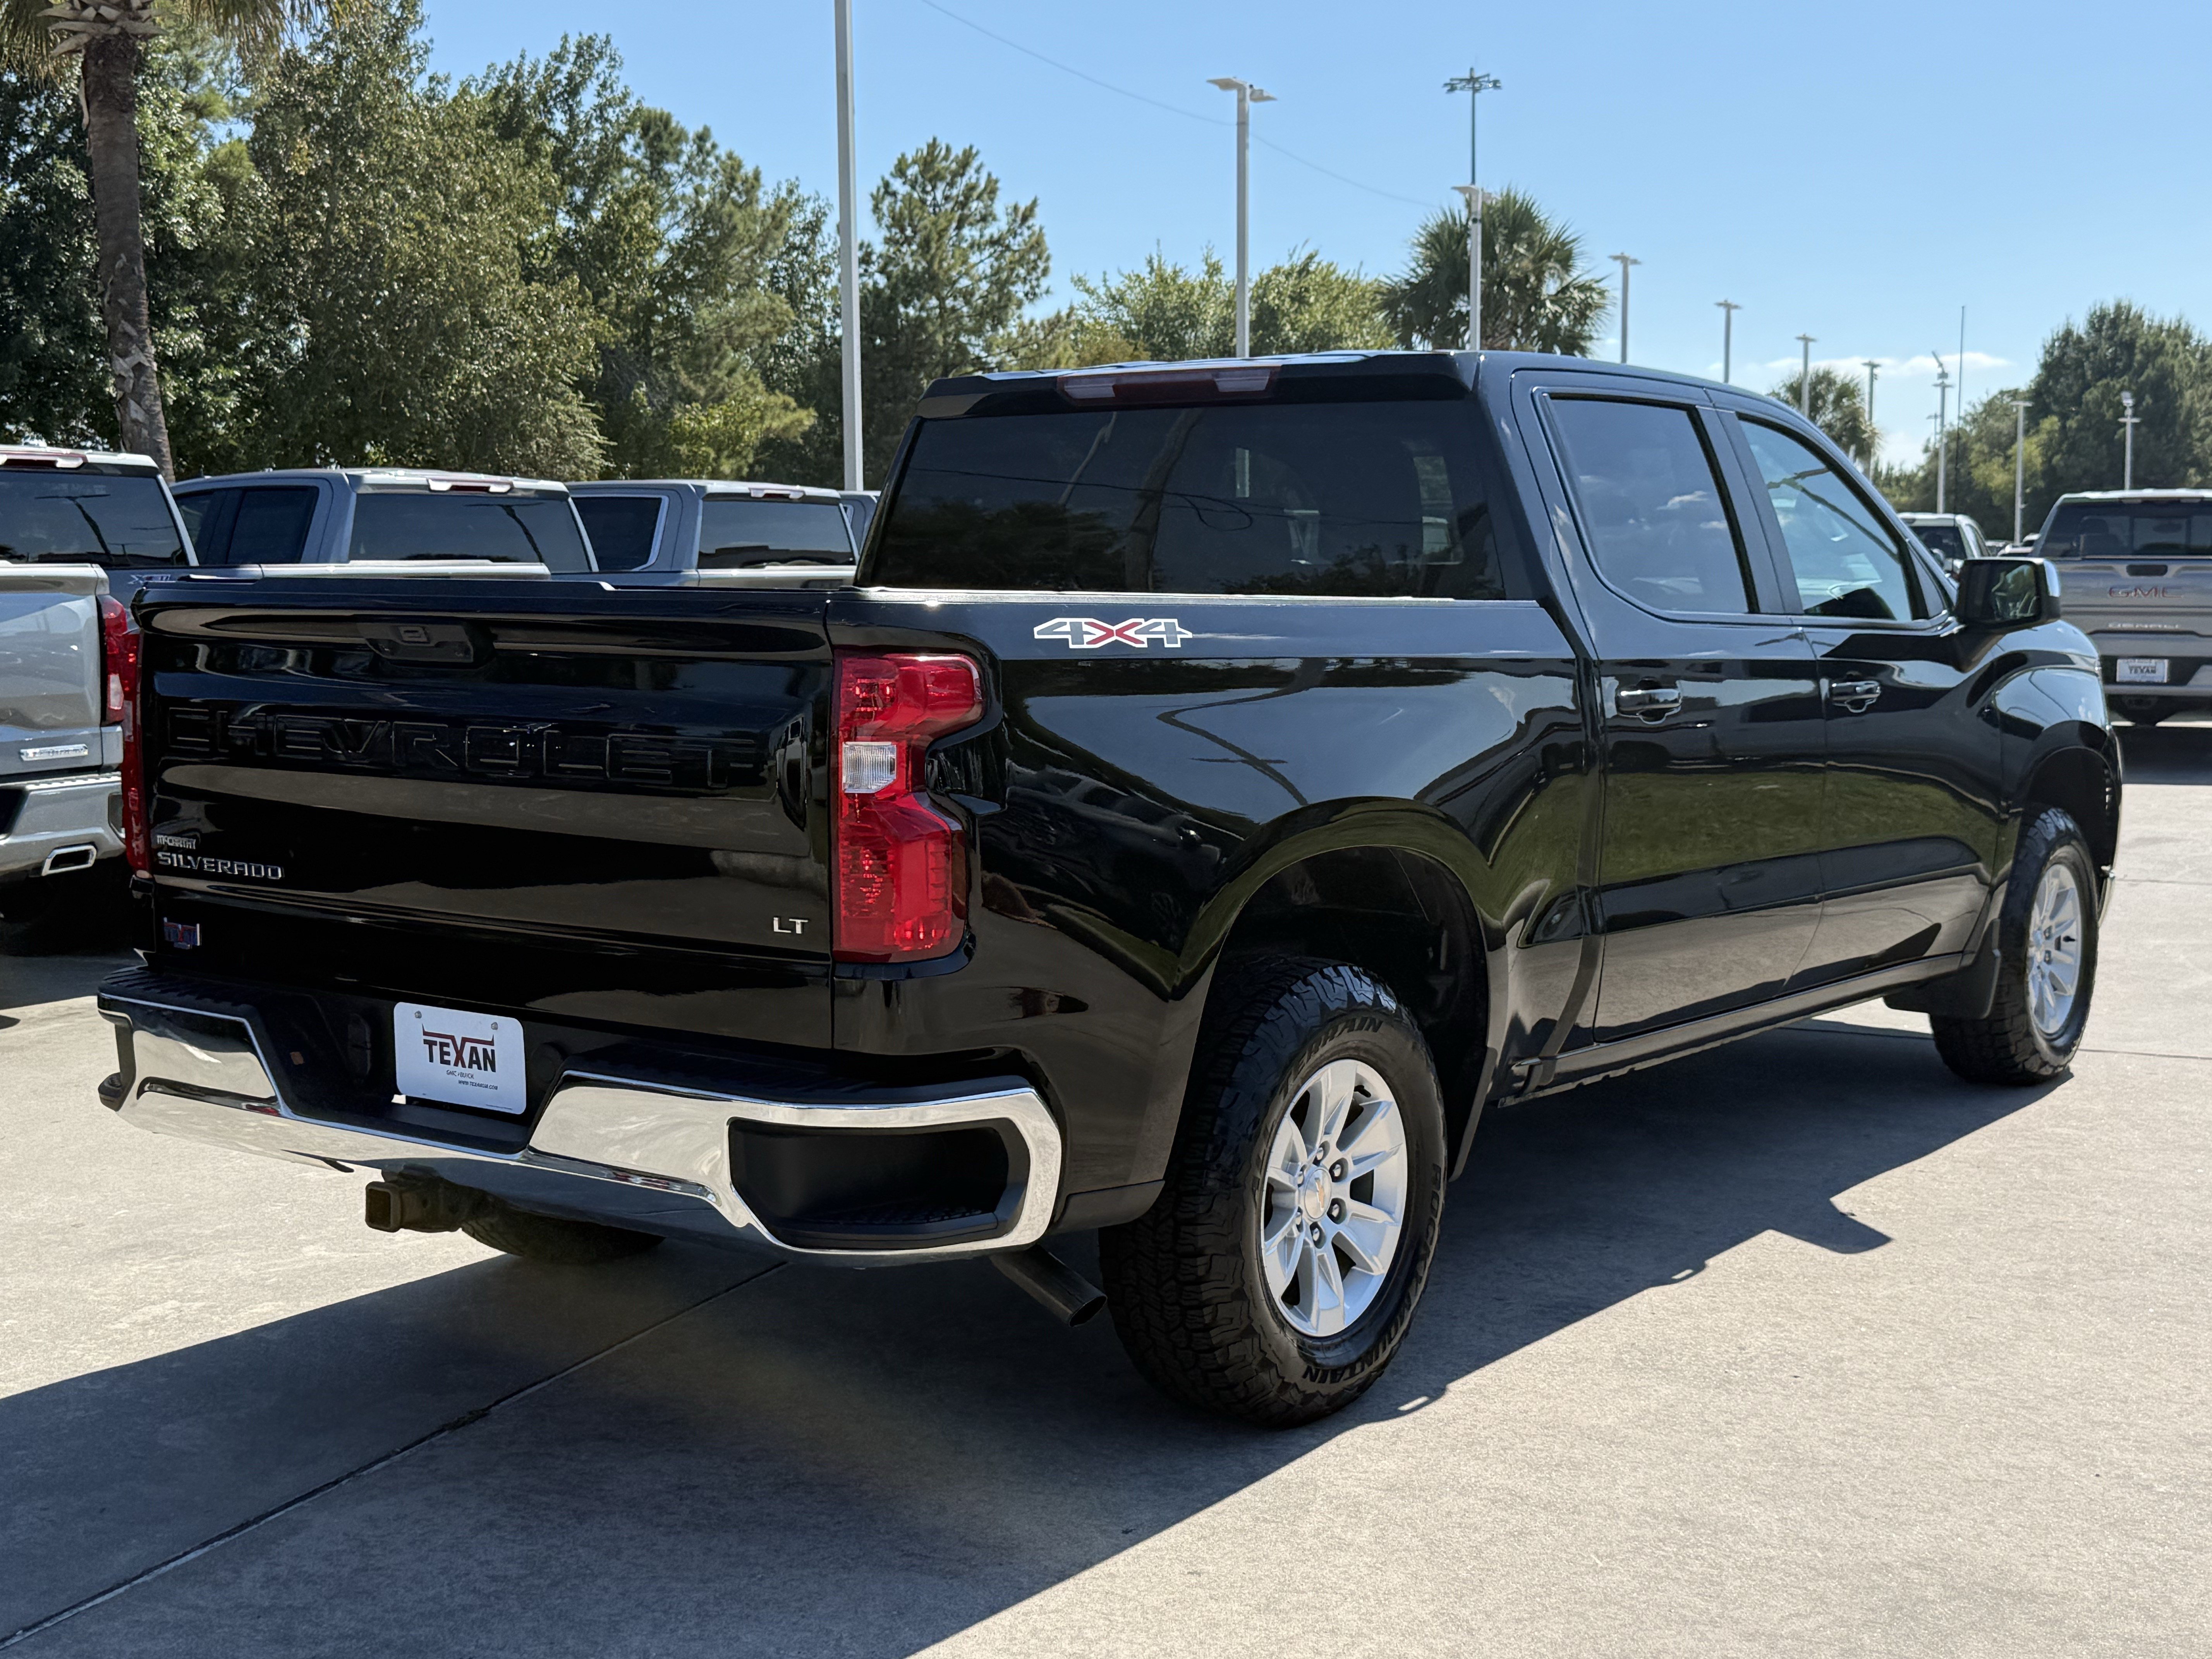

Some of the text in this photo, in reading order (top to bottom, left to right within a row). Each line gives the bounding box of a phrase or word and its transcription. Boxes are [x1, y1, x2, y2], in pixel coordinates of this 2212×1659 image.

[2109, 584, 2183, 598] GMC
[168, 707, 758, 788] CHEVROLET
[157, 852, 285, 880] SILVERADO
[773, 917, 809, 934] LT
[423, 1029, 496, 1072] TEXAN
